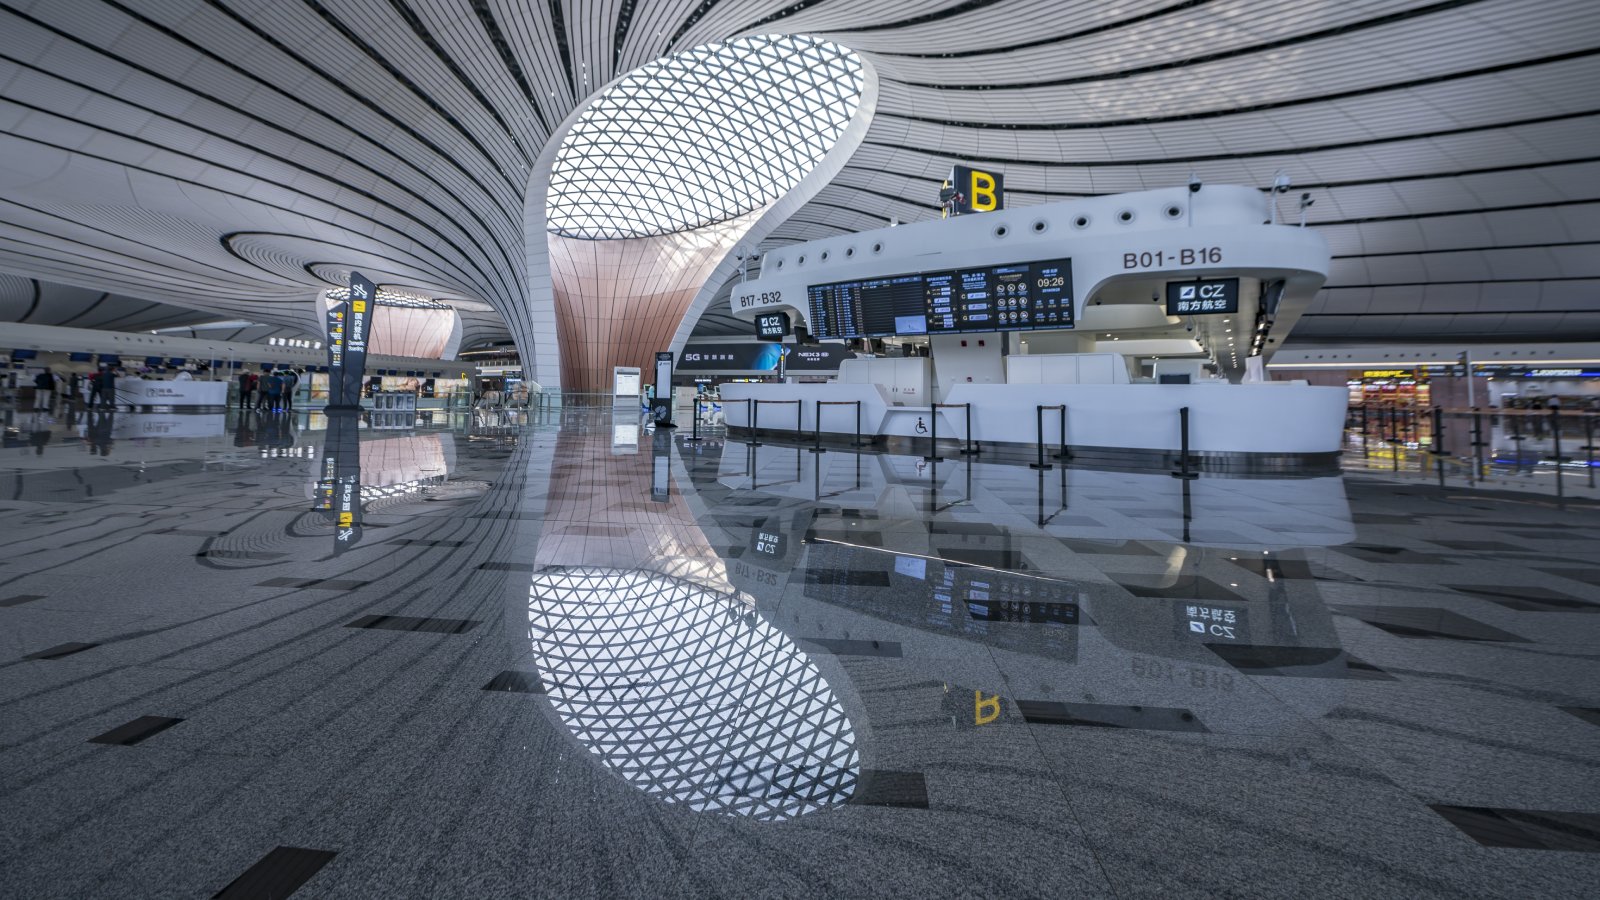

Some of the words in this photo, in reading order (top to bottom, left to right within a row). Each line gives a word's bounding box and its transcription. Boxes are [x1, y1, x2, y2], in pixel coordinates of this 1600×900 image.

[971, 170, 997, 212] B
[1037, 276, 1065, 288] 09:26
[1199, 284, 1225, 298] CZ
[1177, 299, 1227, 312] 南方航空
[769, 316, 781, 326] CZ
[685, 353, 701, 361] 5G
